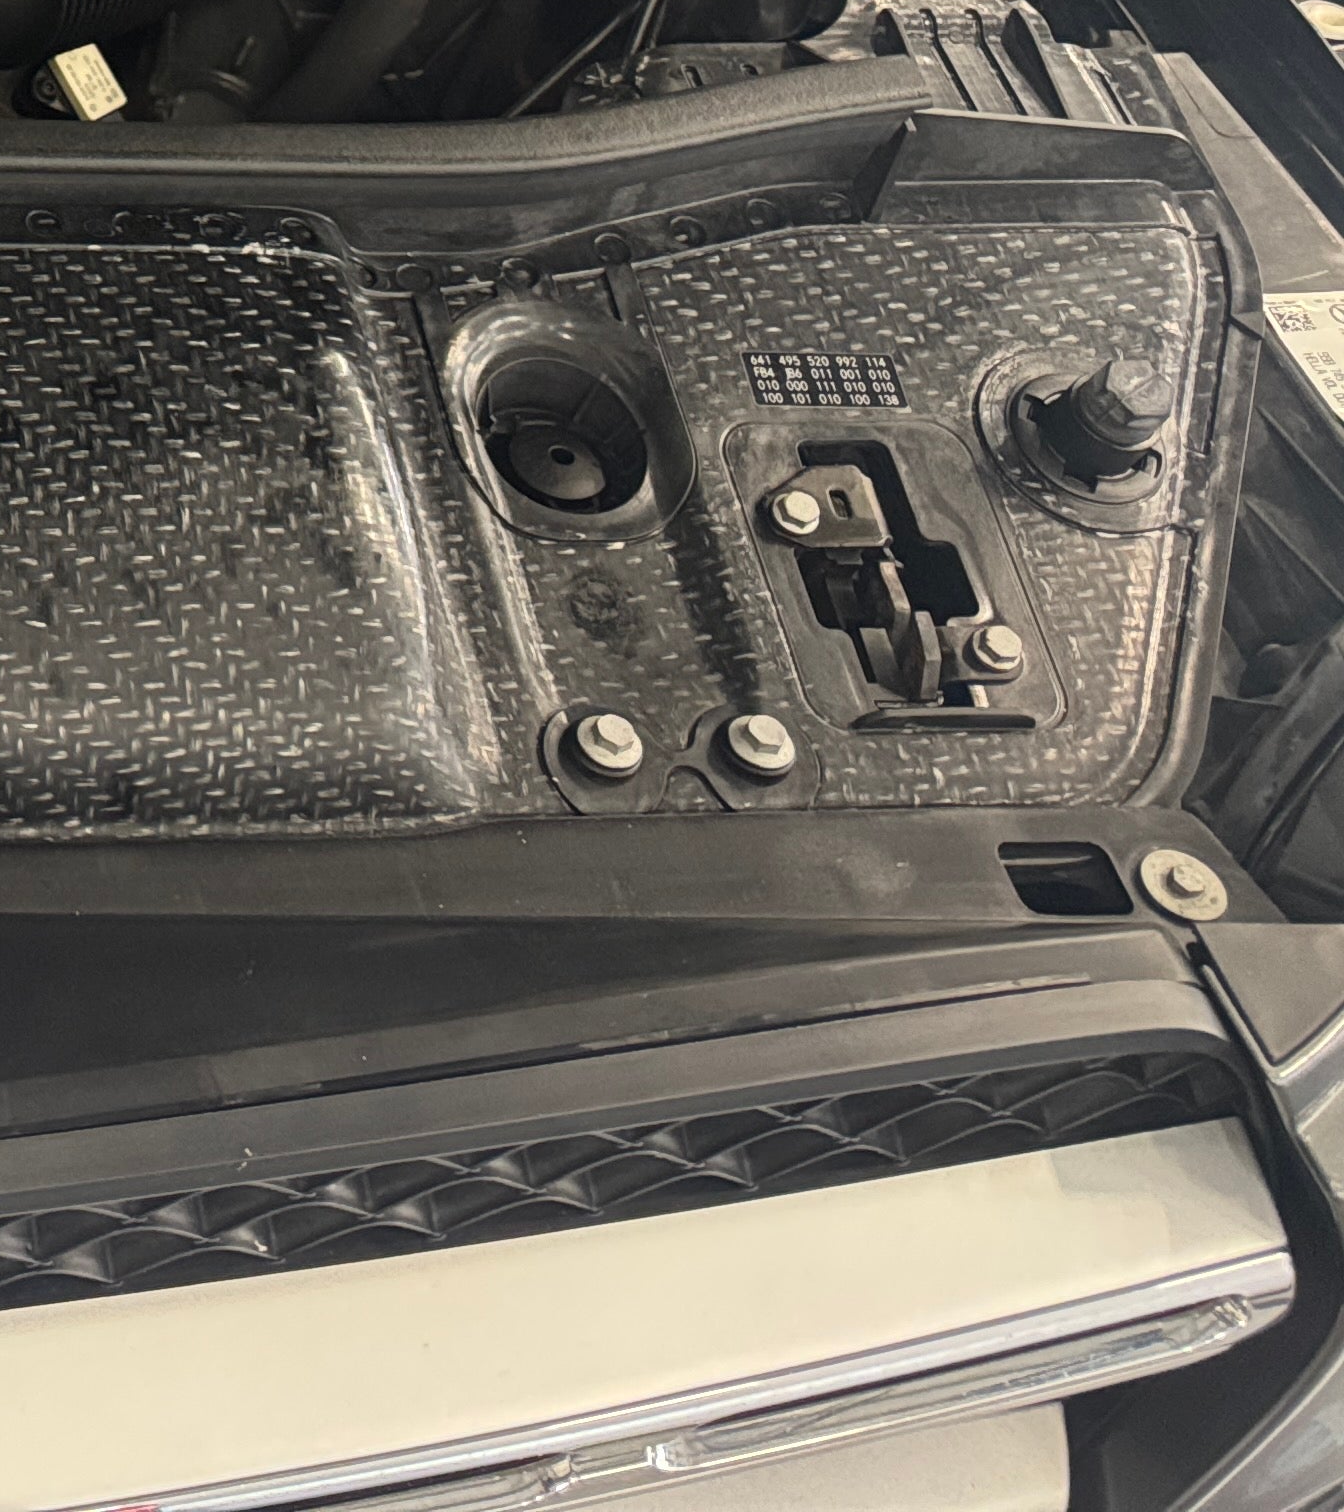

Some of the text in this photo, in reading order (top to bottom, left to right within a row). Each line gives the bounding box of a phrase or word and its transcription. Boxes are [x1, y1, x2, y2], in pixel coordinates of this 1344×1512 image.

[750, 355, 886, 367] 641 495 520 992 114
[753, 366, 775, 378] FB4
[810, 368, 832, 379] 011
[839, 369, 861, 380] 001
[868, 369, 891, 380] 010
[757, 379, 895, 393] 010 000 111 010 010
[762, 392, 784, 403] 100
[791, 393, 812, 404] 101
[818, 393, 842, 405] 010
[849, 394, 871, 405] 100
